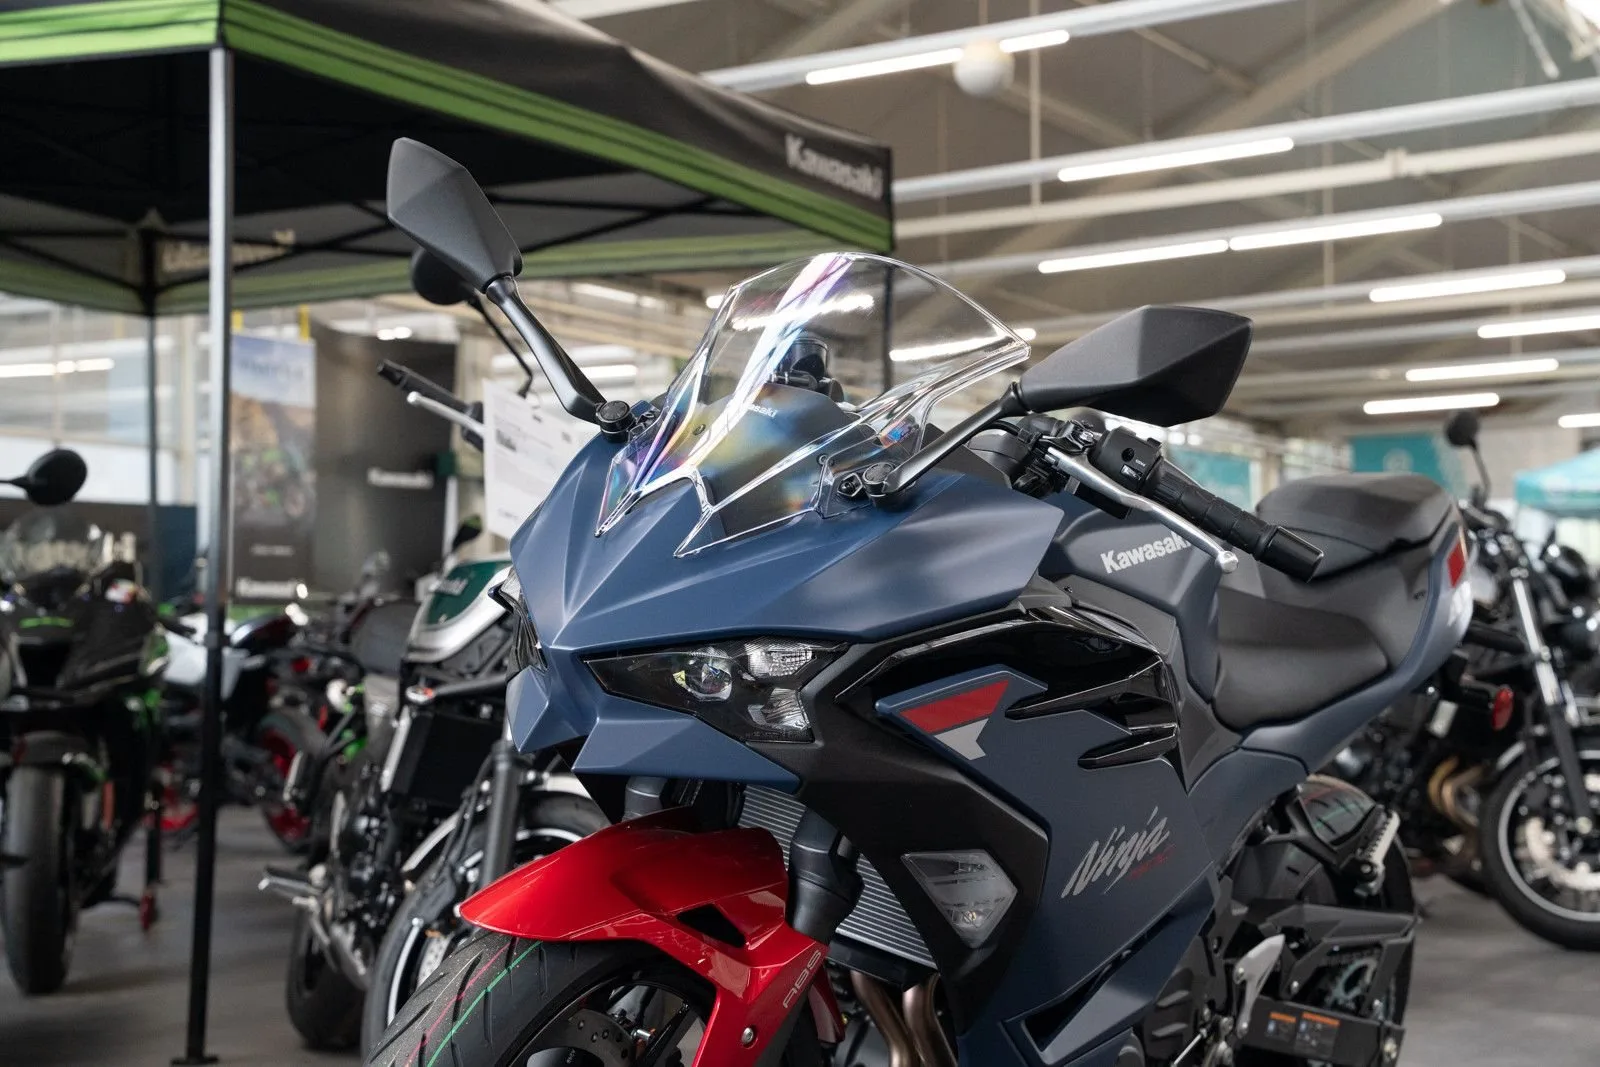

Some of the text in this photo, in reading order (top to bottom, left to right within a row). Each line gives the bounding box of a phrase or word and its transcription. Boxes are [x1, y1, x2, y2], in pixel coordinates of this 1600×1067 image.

[1100, 531, 1192, 574] Kawasak
[1061, 805, 1170, 898] Ninja
[783, 949, 821, 1009] ABS
